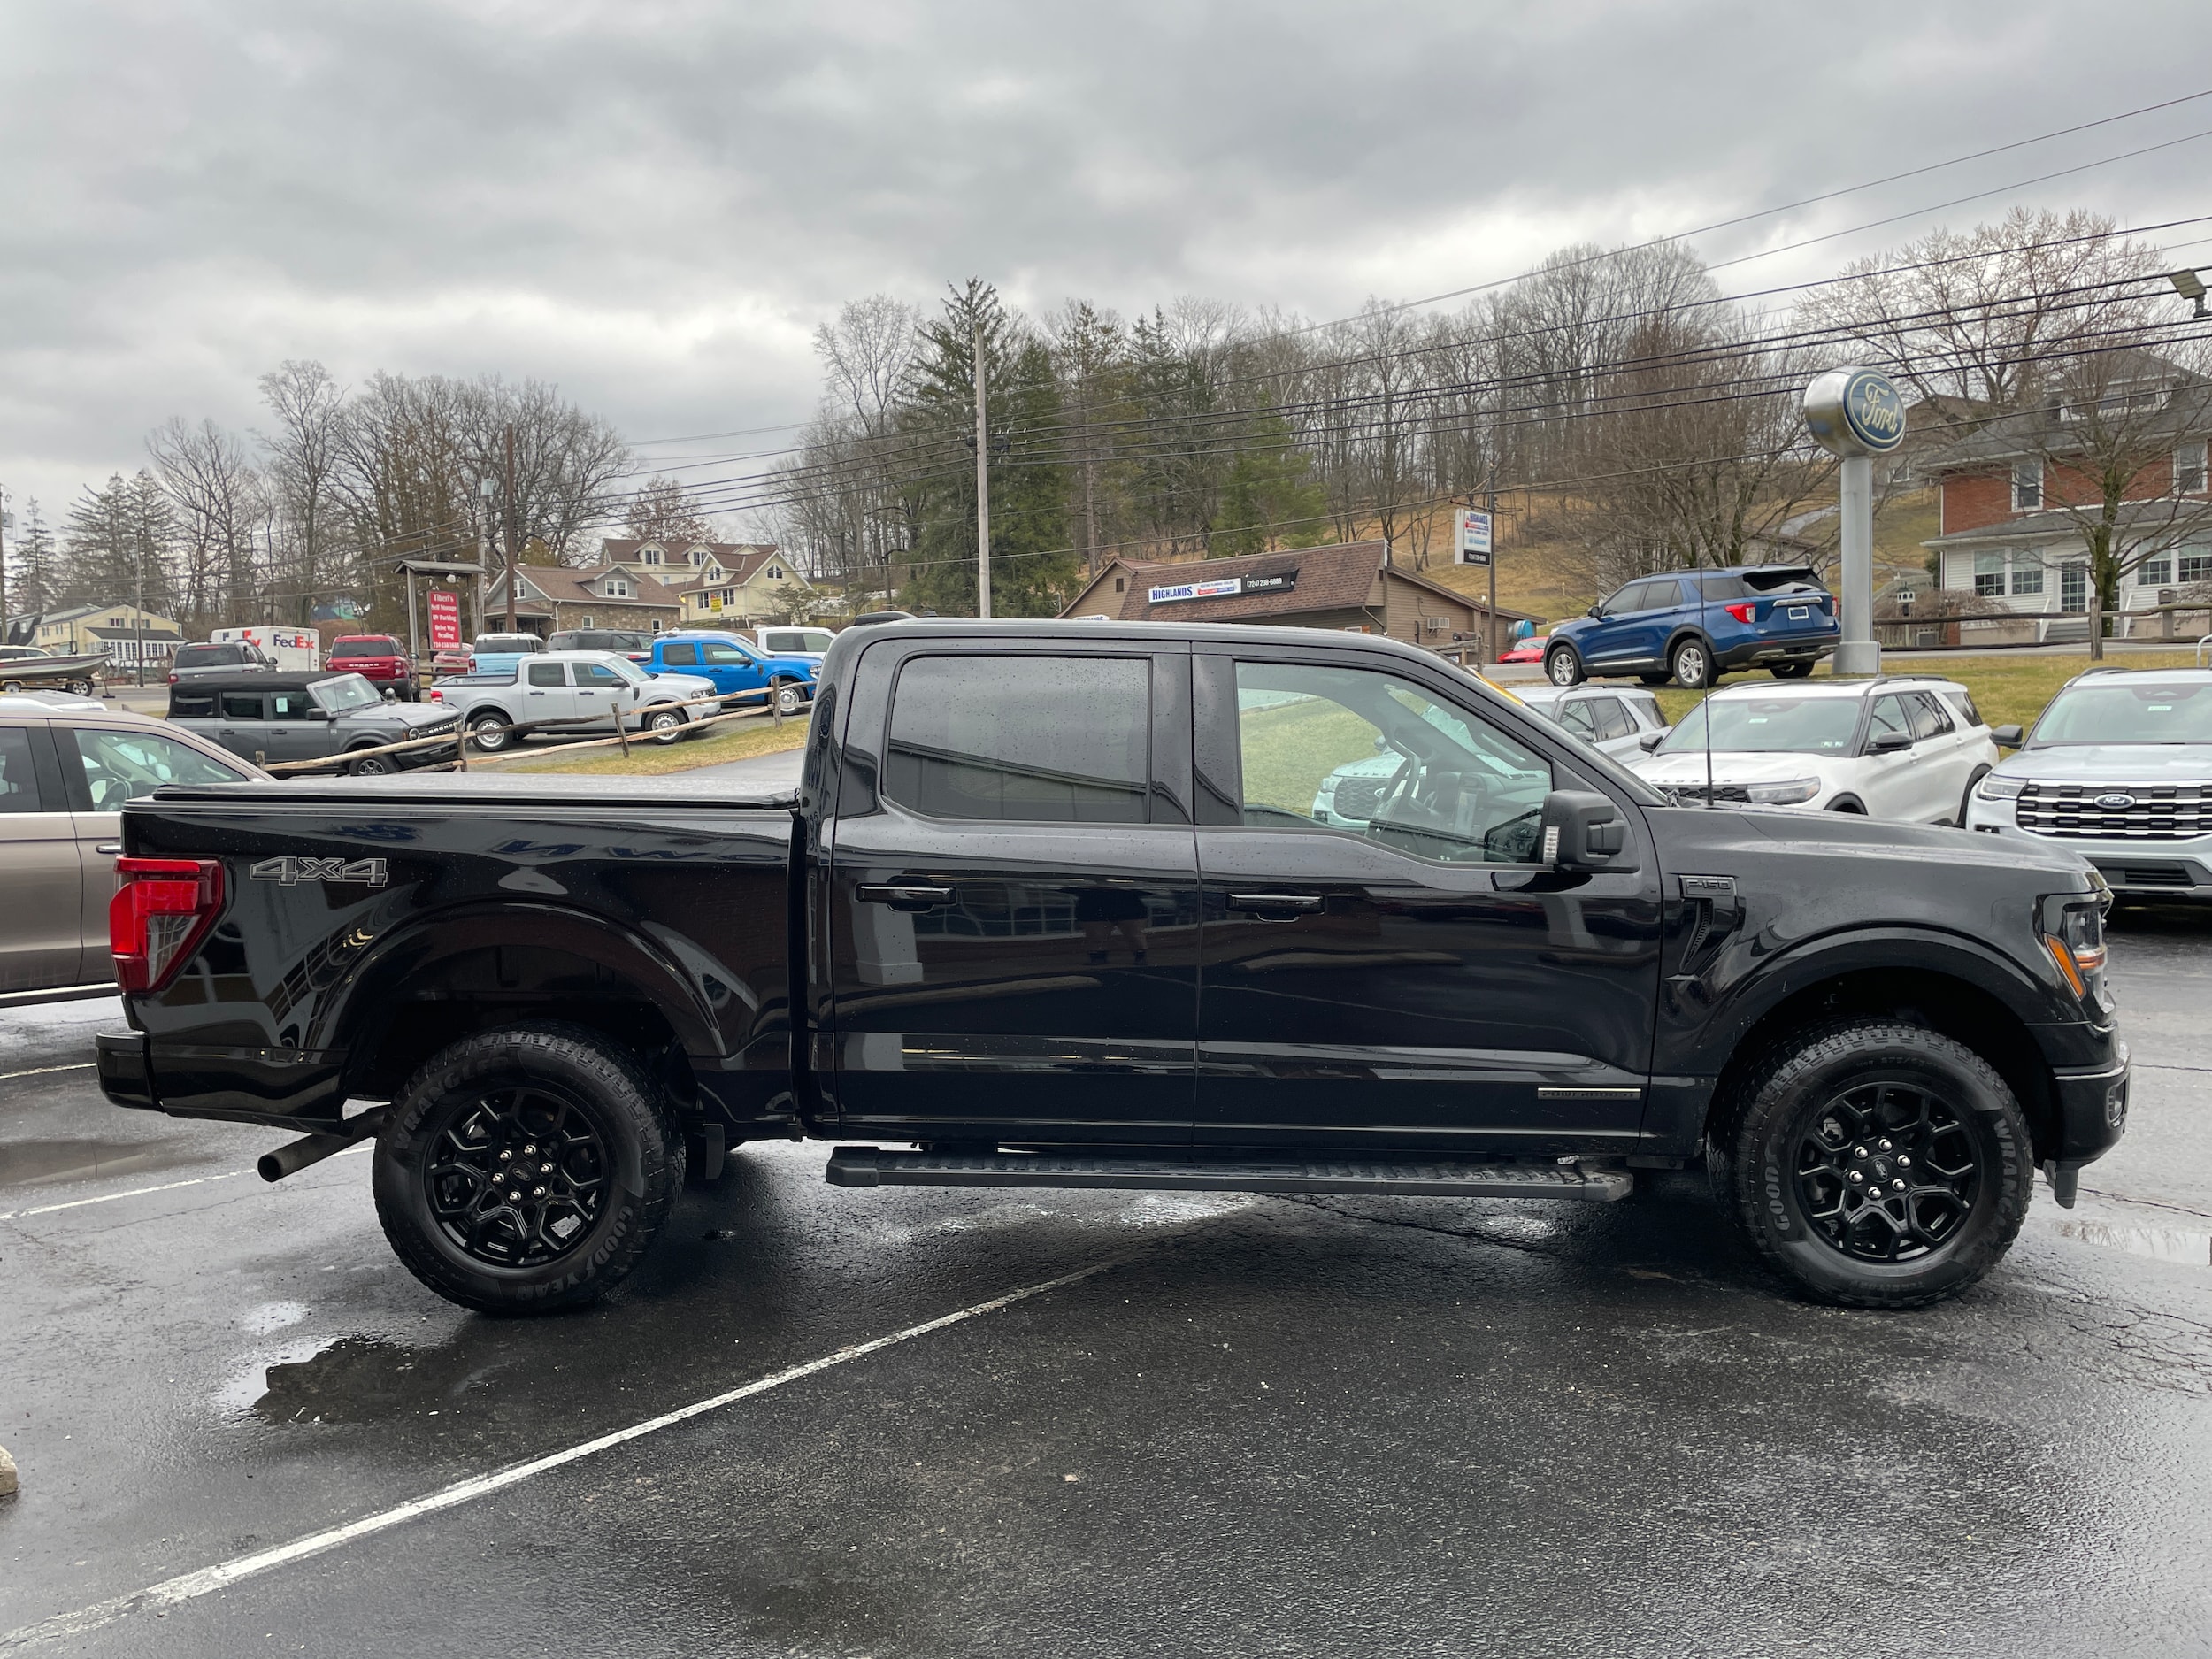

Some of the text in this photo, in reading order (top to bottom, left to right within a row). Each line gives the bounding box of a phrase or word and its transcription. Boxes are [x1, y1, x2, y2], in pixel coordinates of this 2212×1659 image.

[1862, 382, 1898, 434] Ford
[1152, 586, 1193, 601] HIGHLANDS
[273, 634, 314, 649] FedEx
[1686, 879, 1732, 890] F-150
